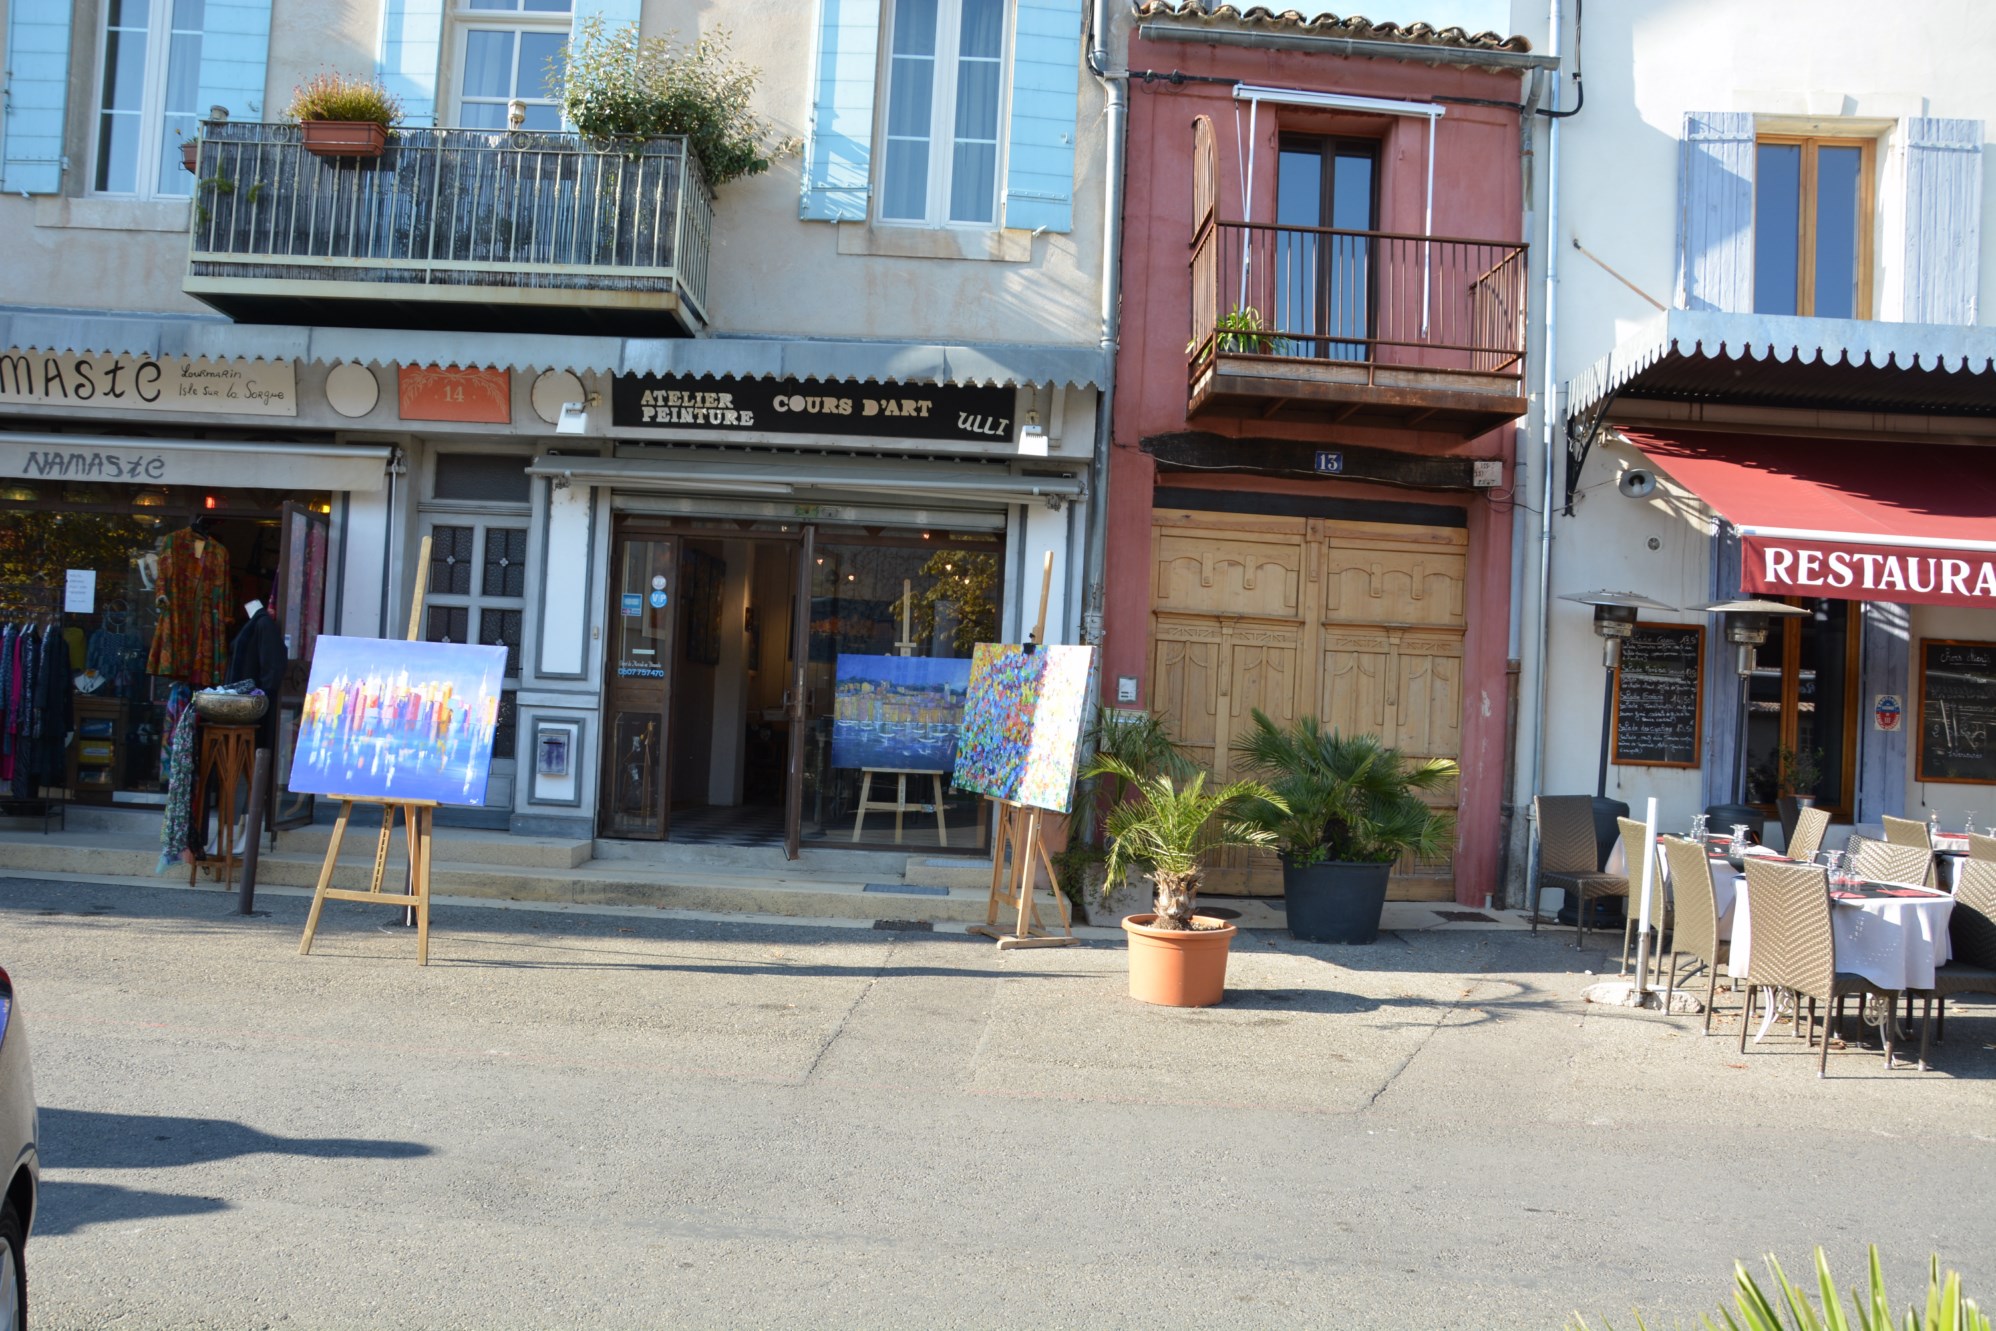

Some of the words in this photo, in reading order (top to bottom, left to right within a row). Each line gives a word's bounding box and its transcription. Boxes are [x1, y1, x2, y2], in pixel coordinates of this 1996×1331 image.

[443, 385, 465, 402] 14
[640, 389, 735, 408] ATELIER
[641, 406, 755, 427] PEINTURE
[772, 395, 853, 415] COURS
[862, 399, 933, 418] D'ART
[957, 411, 1010, 436] ULLI
[1320, 454, 1338, 470] 13
[1763, 547, 1996, 597] RESTAURA
